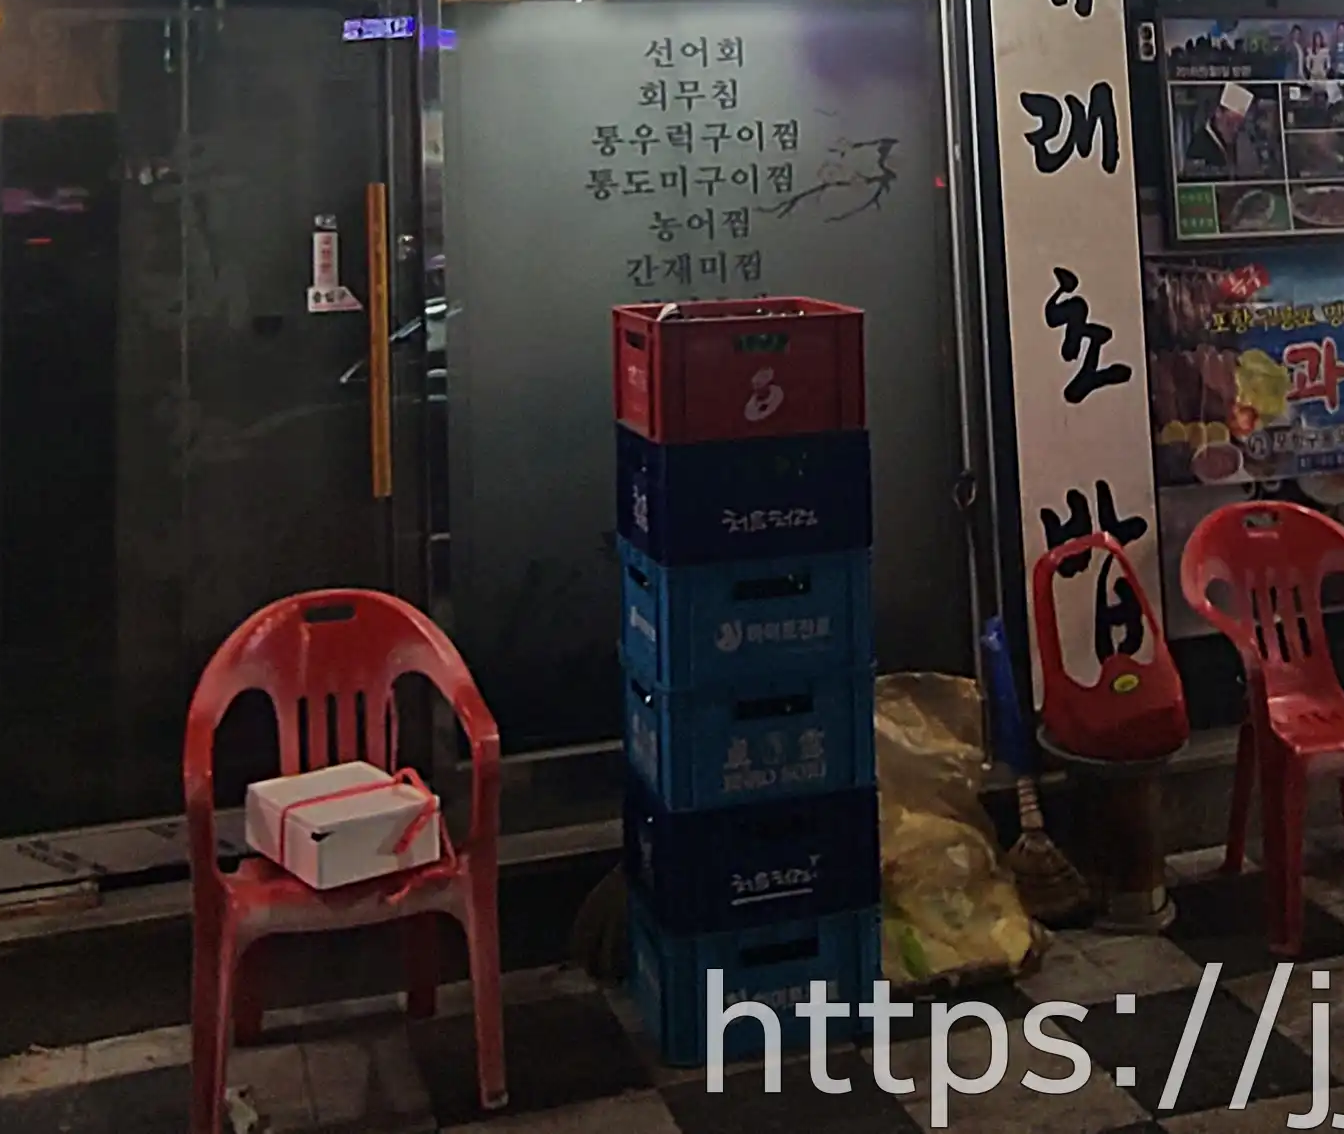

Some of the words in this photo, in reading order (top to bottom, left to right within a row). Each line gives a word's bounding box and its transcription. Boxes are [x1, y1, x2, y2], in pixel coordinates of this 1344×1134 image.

[644, 36, 744, 68] 선어회
[638, 78, 739, 112] 회무침
[591, 119, 800, 158] 통우럭구이찜
[584, 163, 794, 201] 통도미구이찜
[648, 206, 751, 243] 농어찜
[626, 250, 763, 288] 간재미찜
